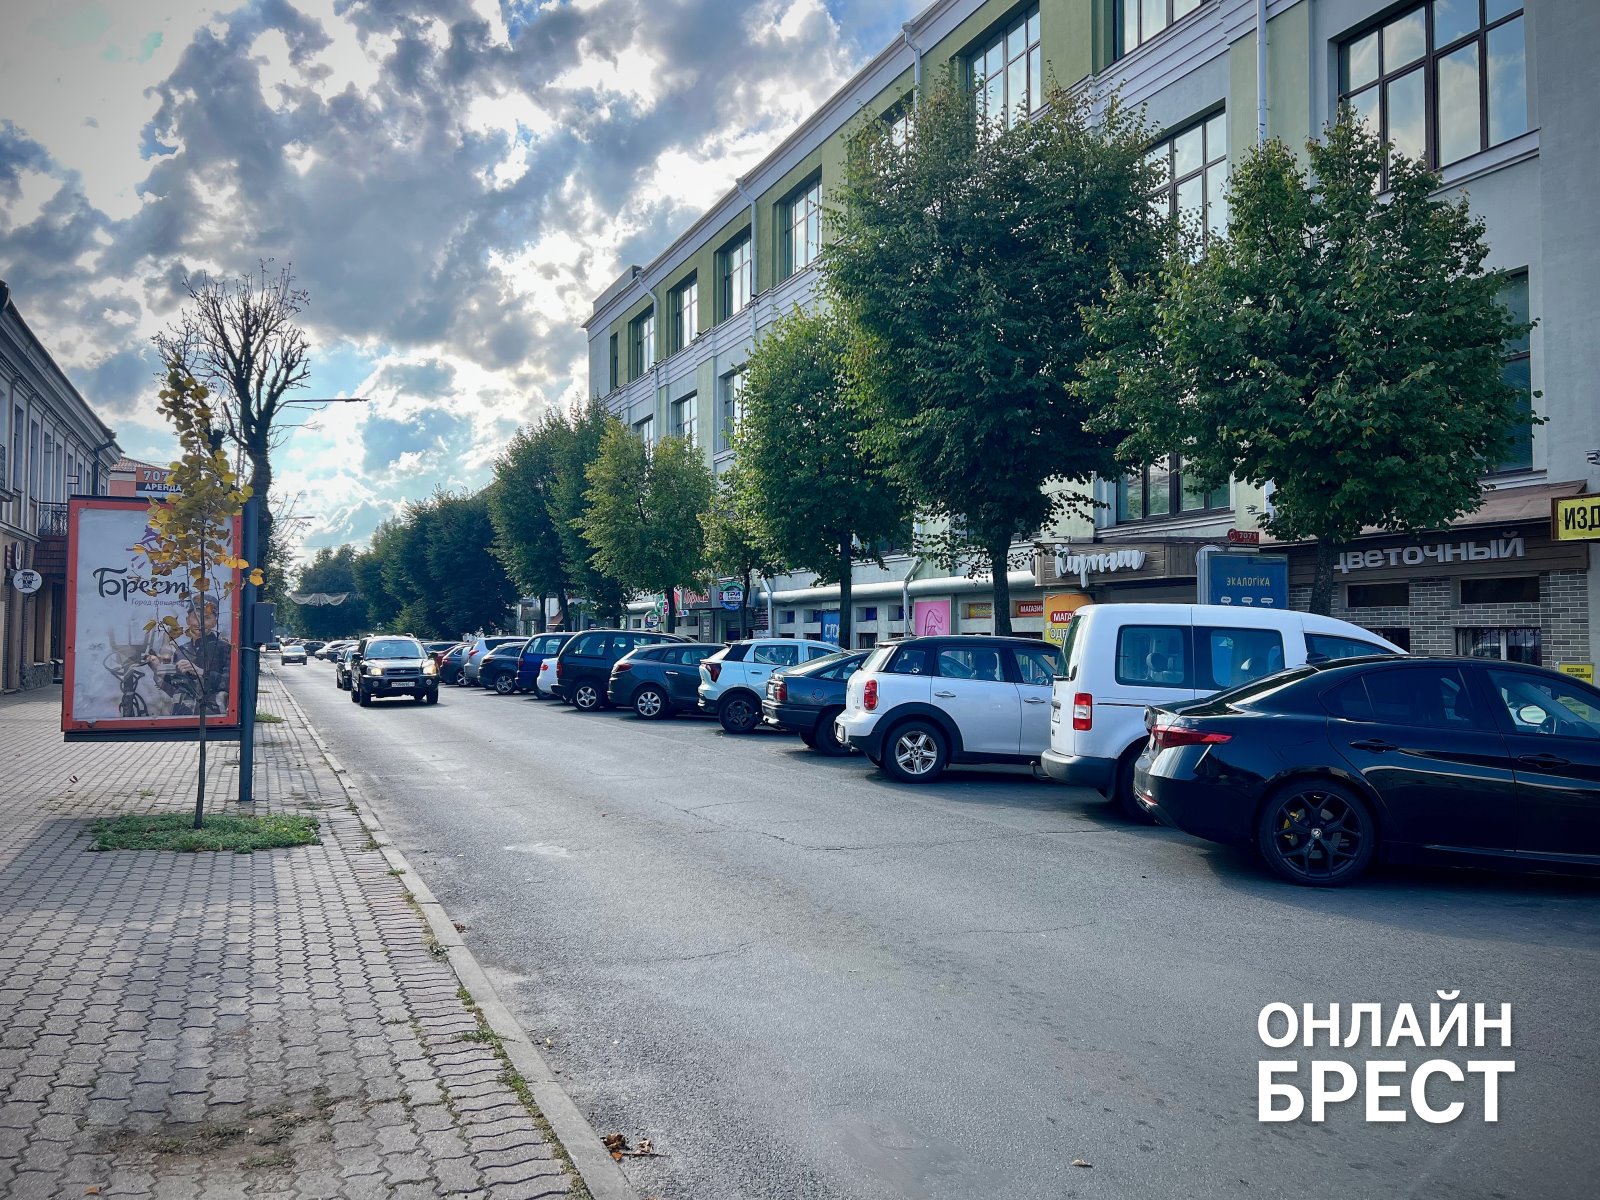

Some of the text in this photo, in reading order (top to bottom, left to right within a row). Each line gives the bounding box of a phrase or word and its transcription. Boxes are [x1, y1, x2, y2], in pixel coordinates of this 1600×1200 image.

[144, 483, 182, 492] АРЕНДА
[92, 567, 188, 602] Брест
[131, 598, 152, 607] Город
